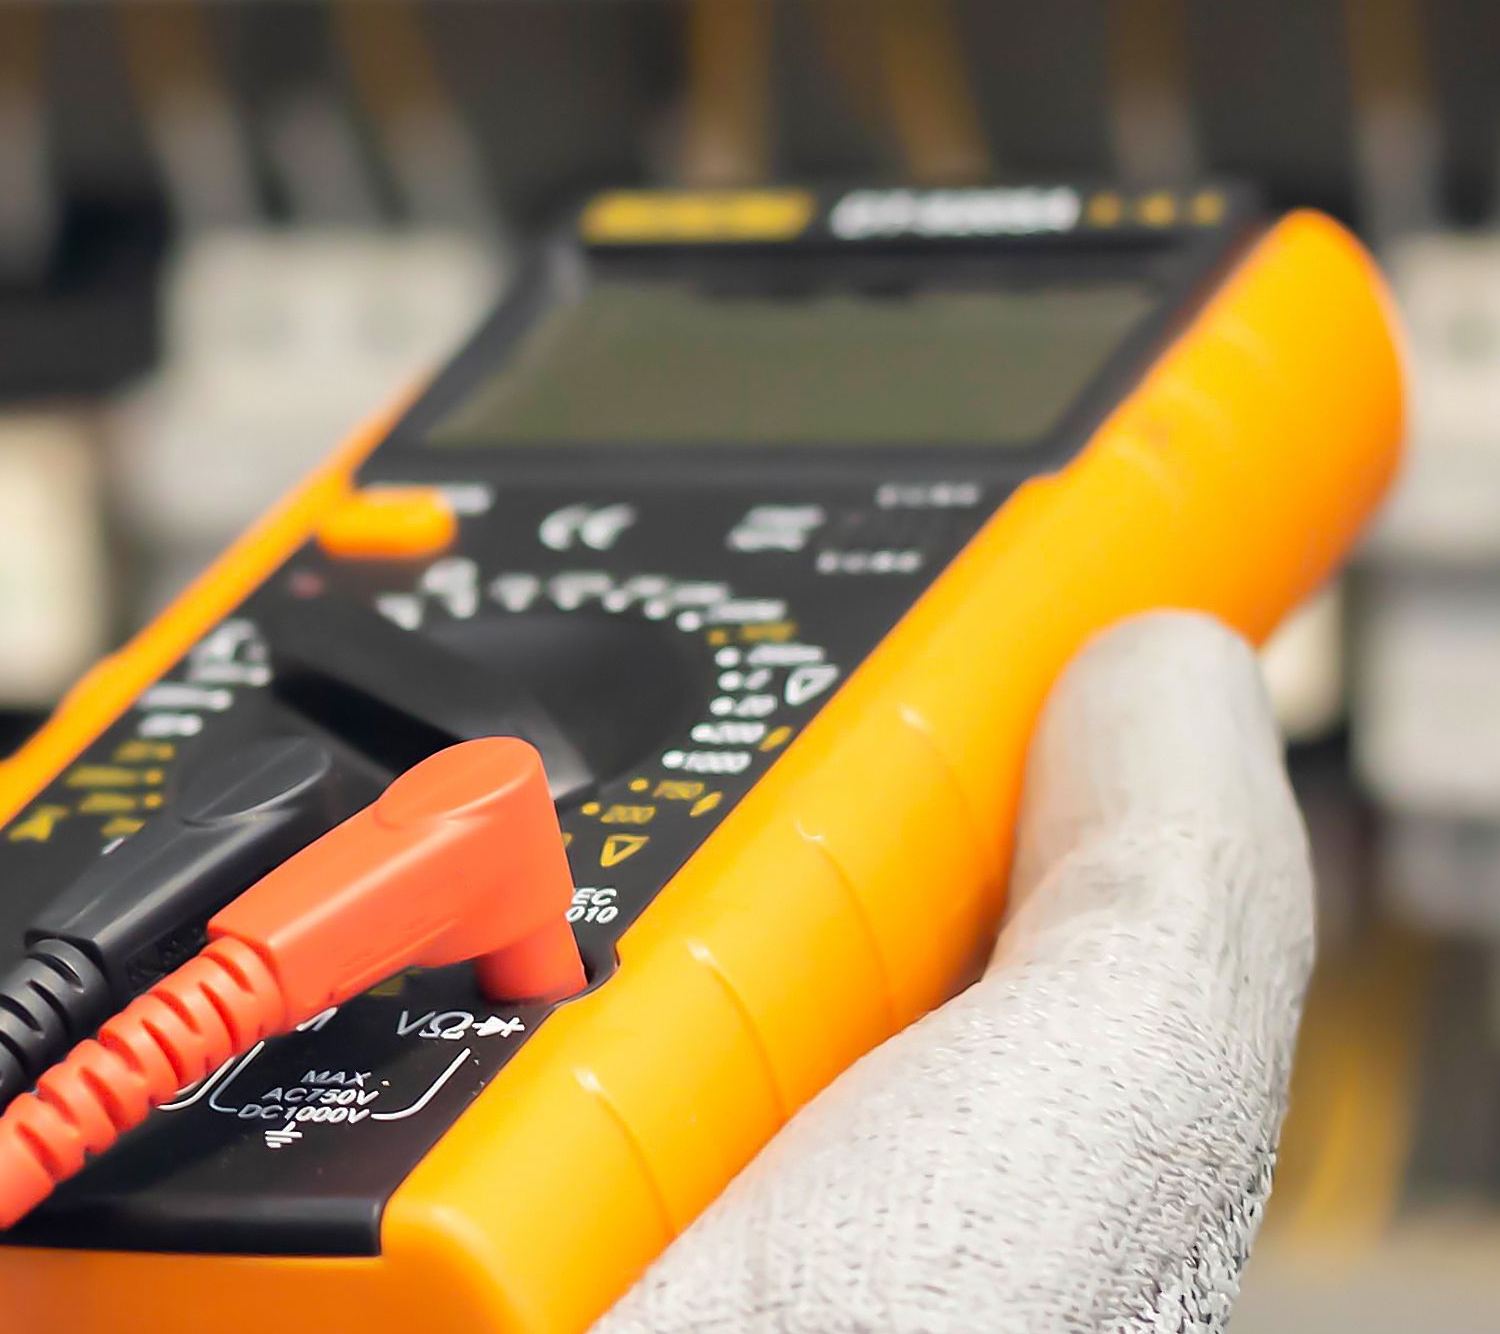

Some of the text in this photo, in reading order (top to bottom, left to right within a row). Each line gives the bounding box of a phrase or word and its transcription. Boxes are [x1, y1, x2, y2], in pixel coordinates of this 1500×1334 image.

[683, 750, 751, 773] 1000
[571, 887, 617, 906] EC
[565, 906, 619, 924] 010
[300, 1069, 372, 1087] MAX
[261, 1086, 380, 1105] AC750V
[237, 1103, 370, 1124] DC1000V
